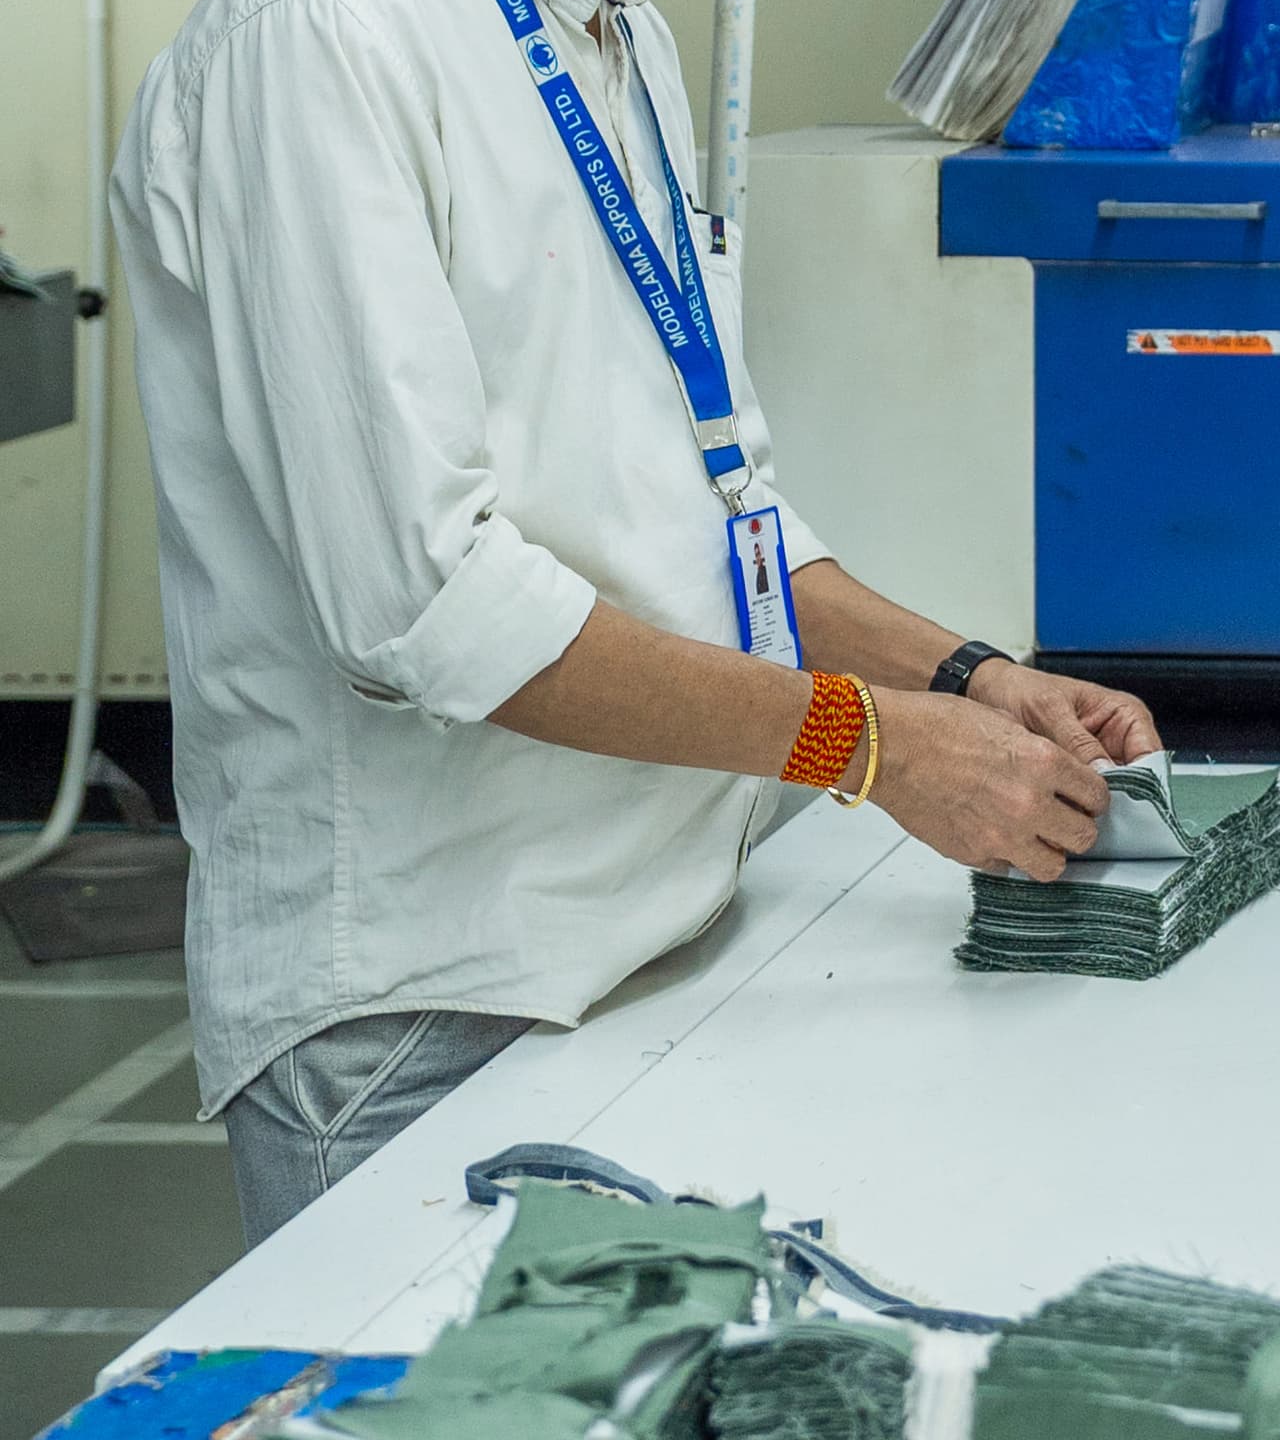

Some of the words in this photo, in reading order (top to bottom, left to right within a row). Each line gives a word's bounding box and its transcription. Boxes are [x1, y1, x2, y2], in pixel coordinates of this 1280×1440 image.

[555, 86, 582, 130] LTD.
[573, 129, 600, 157] (P)
[586, 158, 638, 246] EXPORTS
[627, 242, 689, 349] MODELAMA
